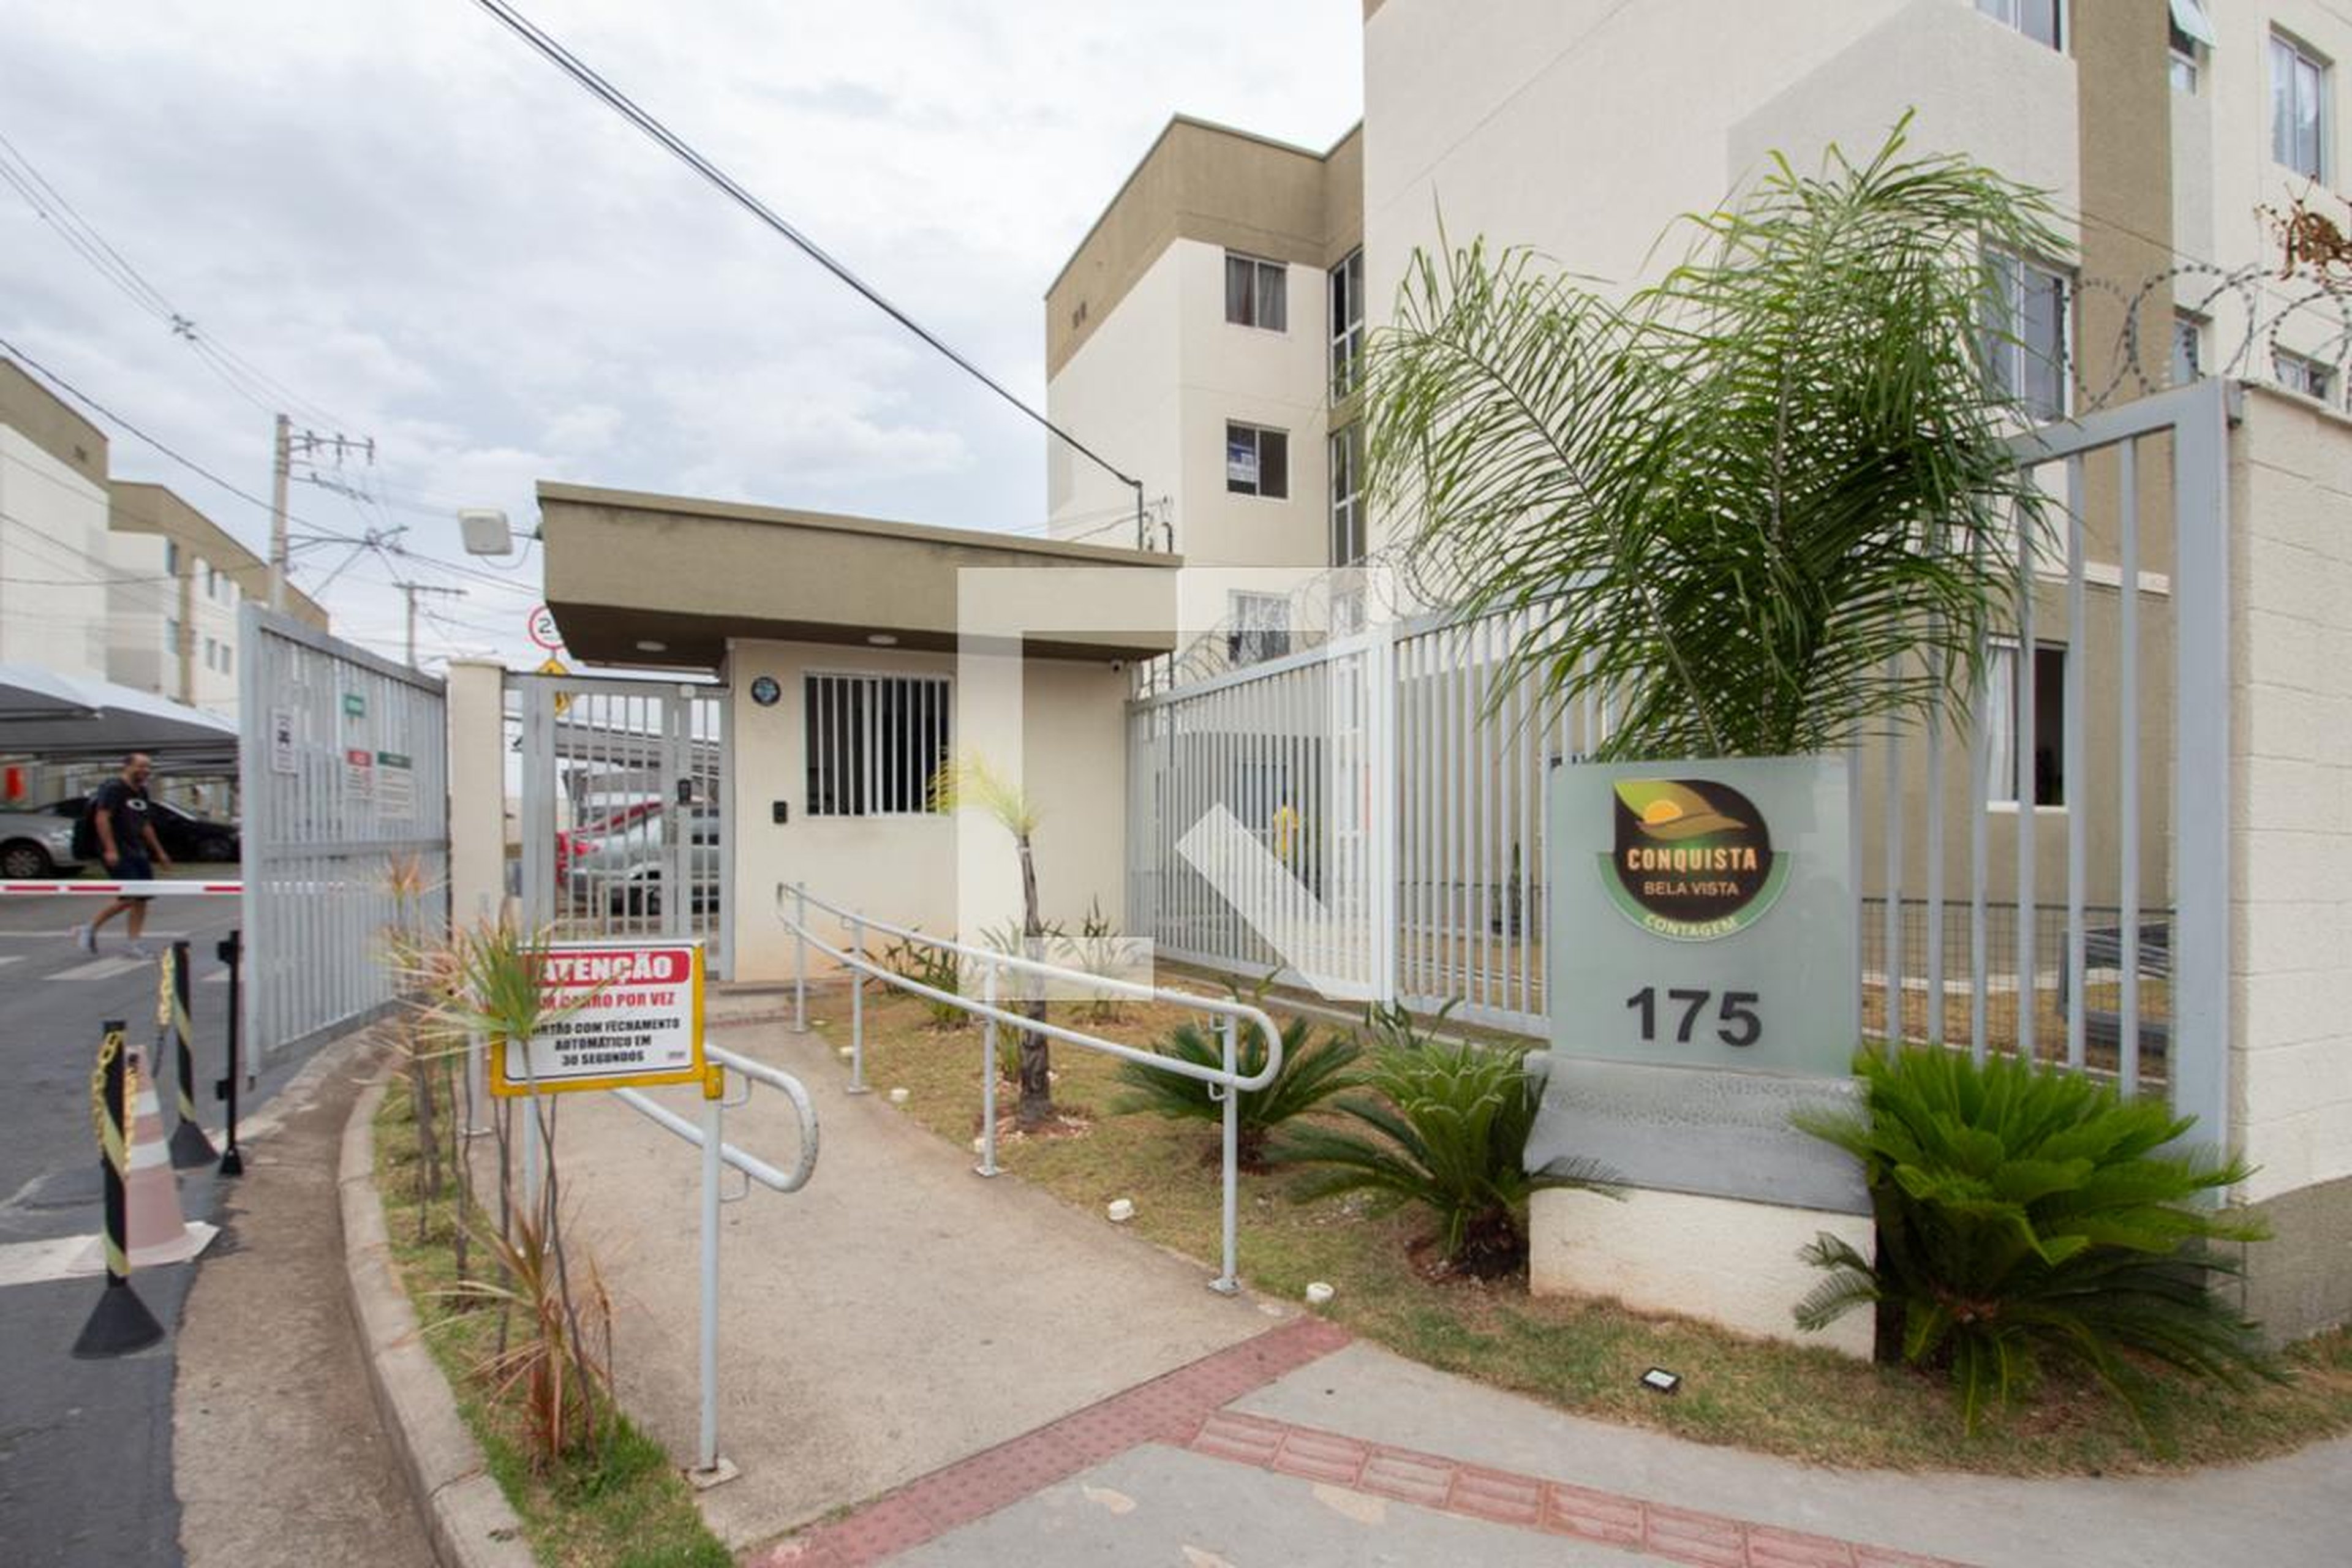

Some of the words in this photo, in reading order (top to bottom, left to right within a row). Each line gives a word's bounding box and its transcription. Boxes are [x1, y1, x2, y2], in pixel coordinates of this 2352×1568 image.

[1627, 848, 1757, 873] CONQUISTA
[1644, 881, 1687, 896] BELA
[1691, 881, 1740, 897] VISTA
[1645, 914, 1738, 937] CONTAGEM
[544, 950, 673, 984] ATENÇÃO
[616, 993, 647, 1008] POR
[650, 991, 675, 1006] VEZ
[1626, 987, 1762, 1047] 175
[575, 1022, 603, 1035] COM
[605, 1018, 680, 1033] FECHAMENTO
[635, 1035, 652, 1046] EM
[562, 1054, 578, 1066] 30
[582, 1050, 645, 1065] SEGUNDOS
